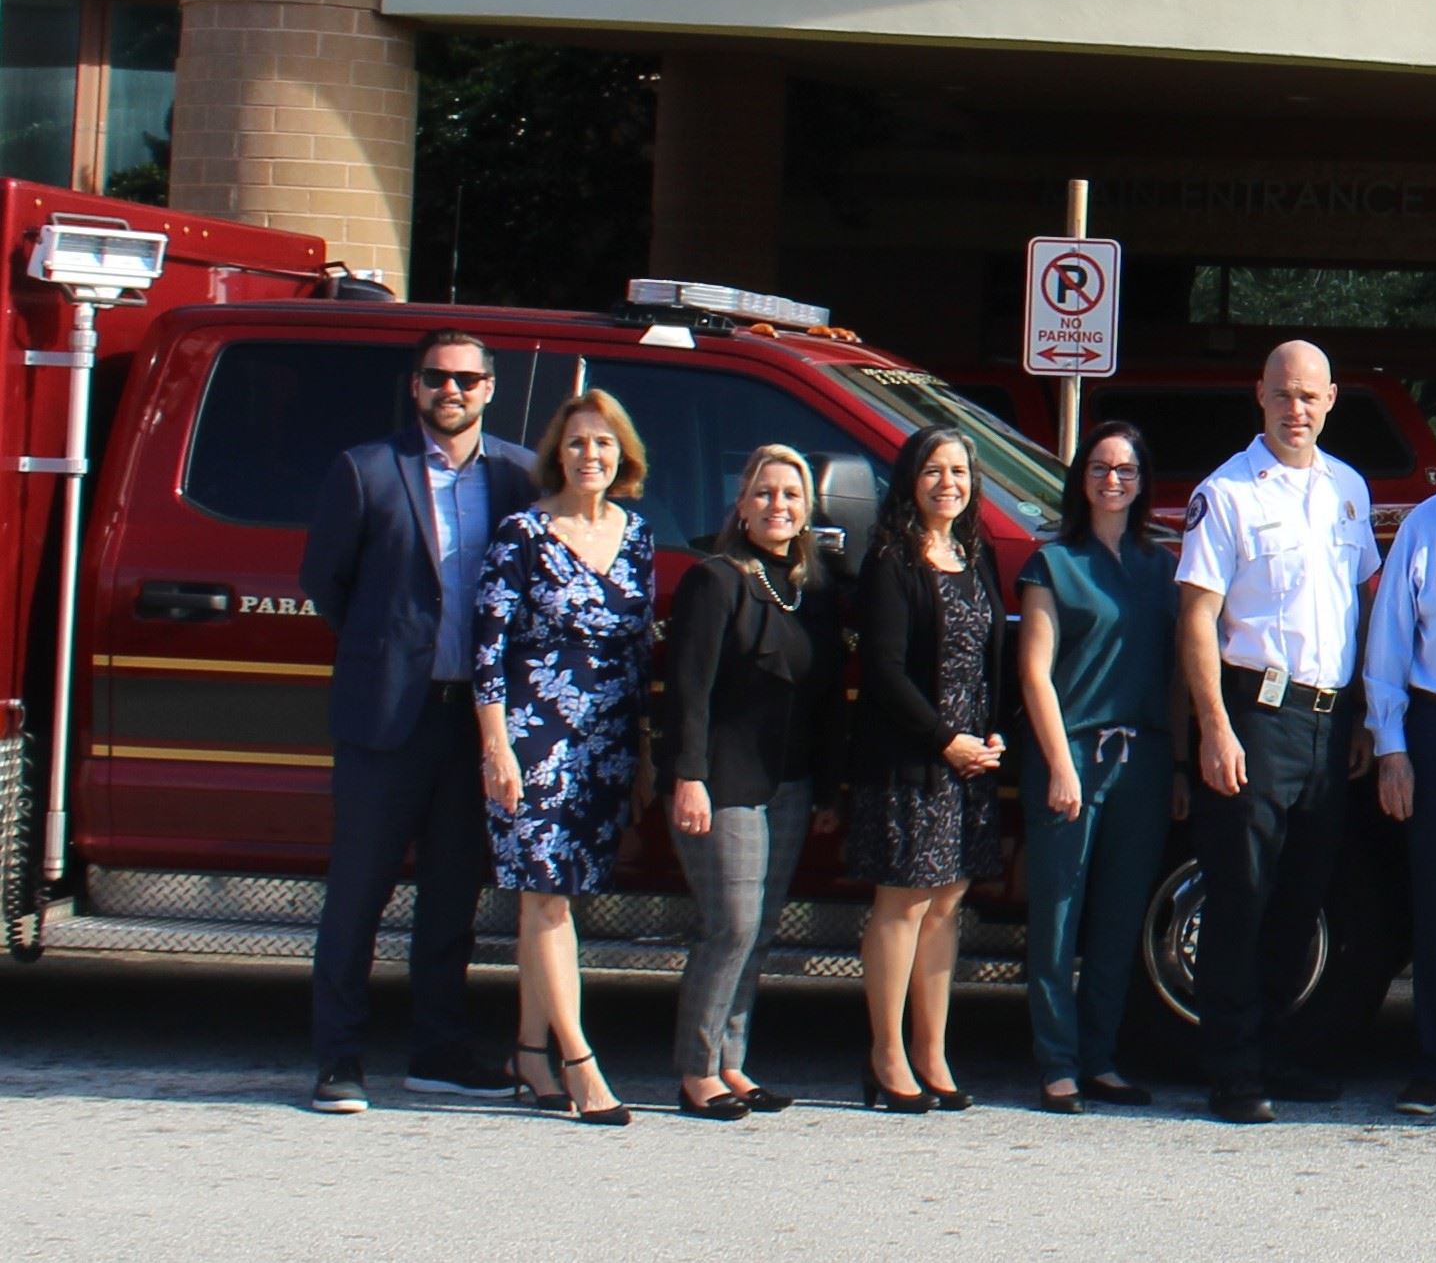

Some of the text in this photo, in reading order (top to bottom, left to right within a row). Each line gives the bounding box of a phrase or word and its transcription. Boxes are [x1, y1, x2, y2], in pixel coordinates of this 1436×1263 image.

[1180, 177, 1426, 218] ENTRANCE
[1059, 317, 1082, 330] NO
[1037, 330, 1104, 343] PARKING
[239, 595, 320, 616] PARA
